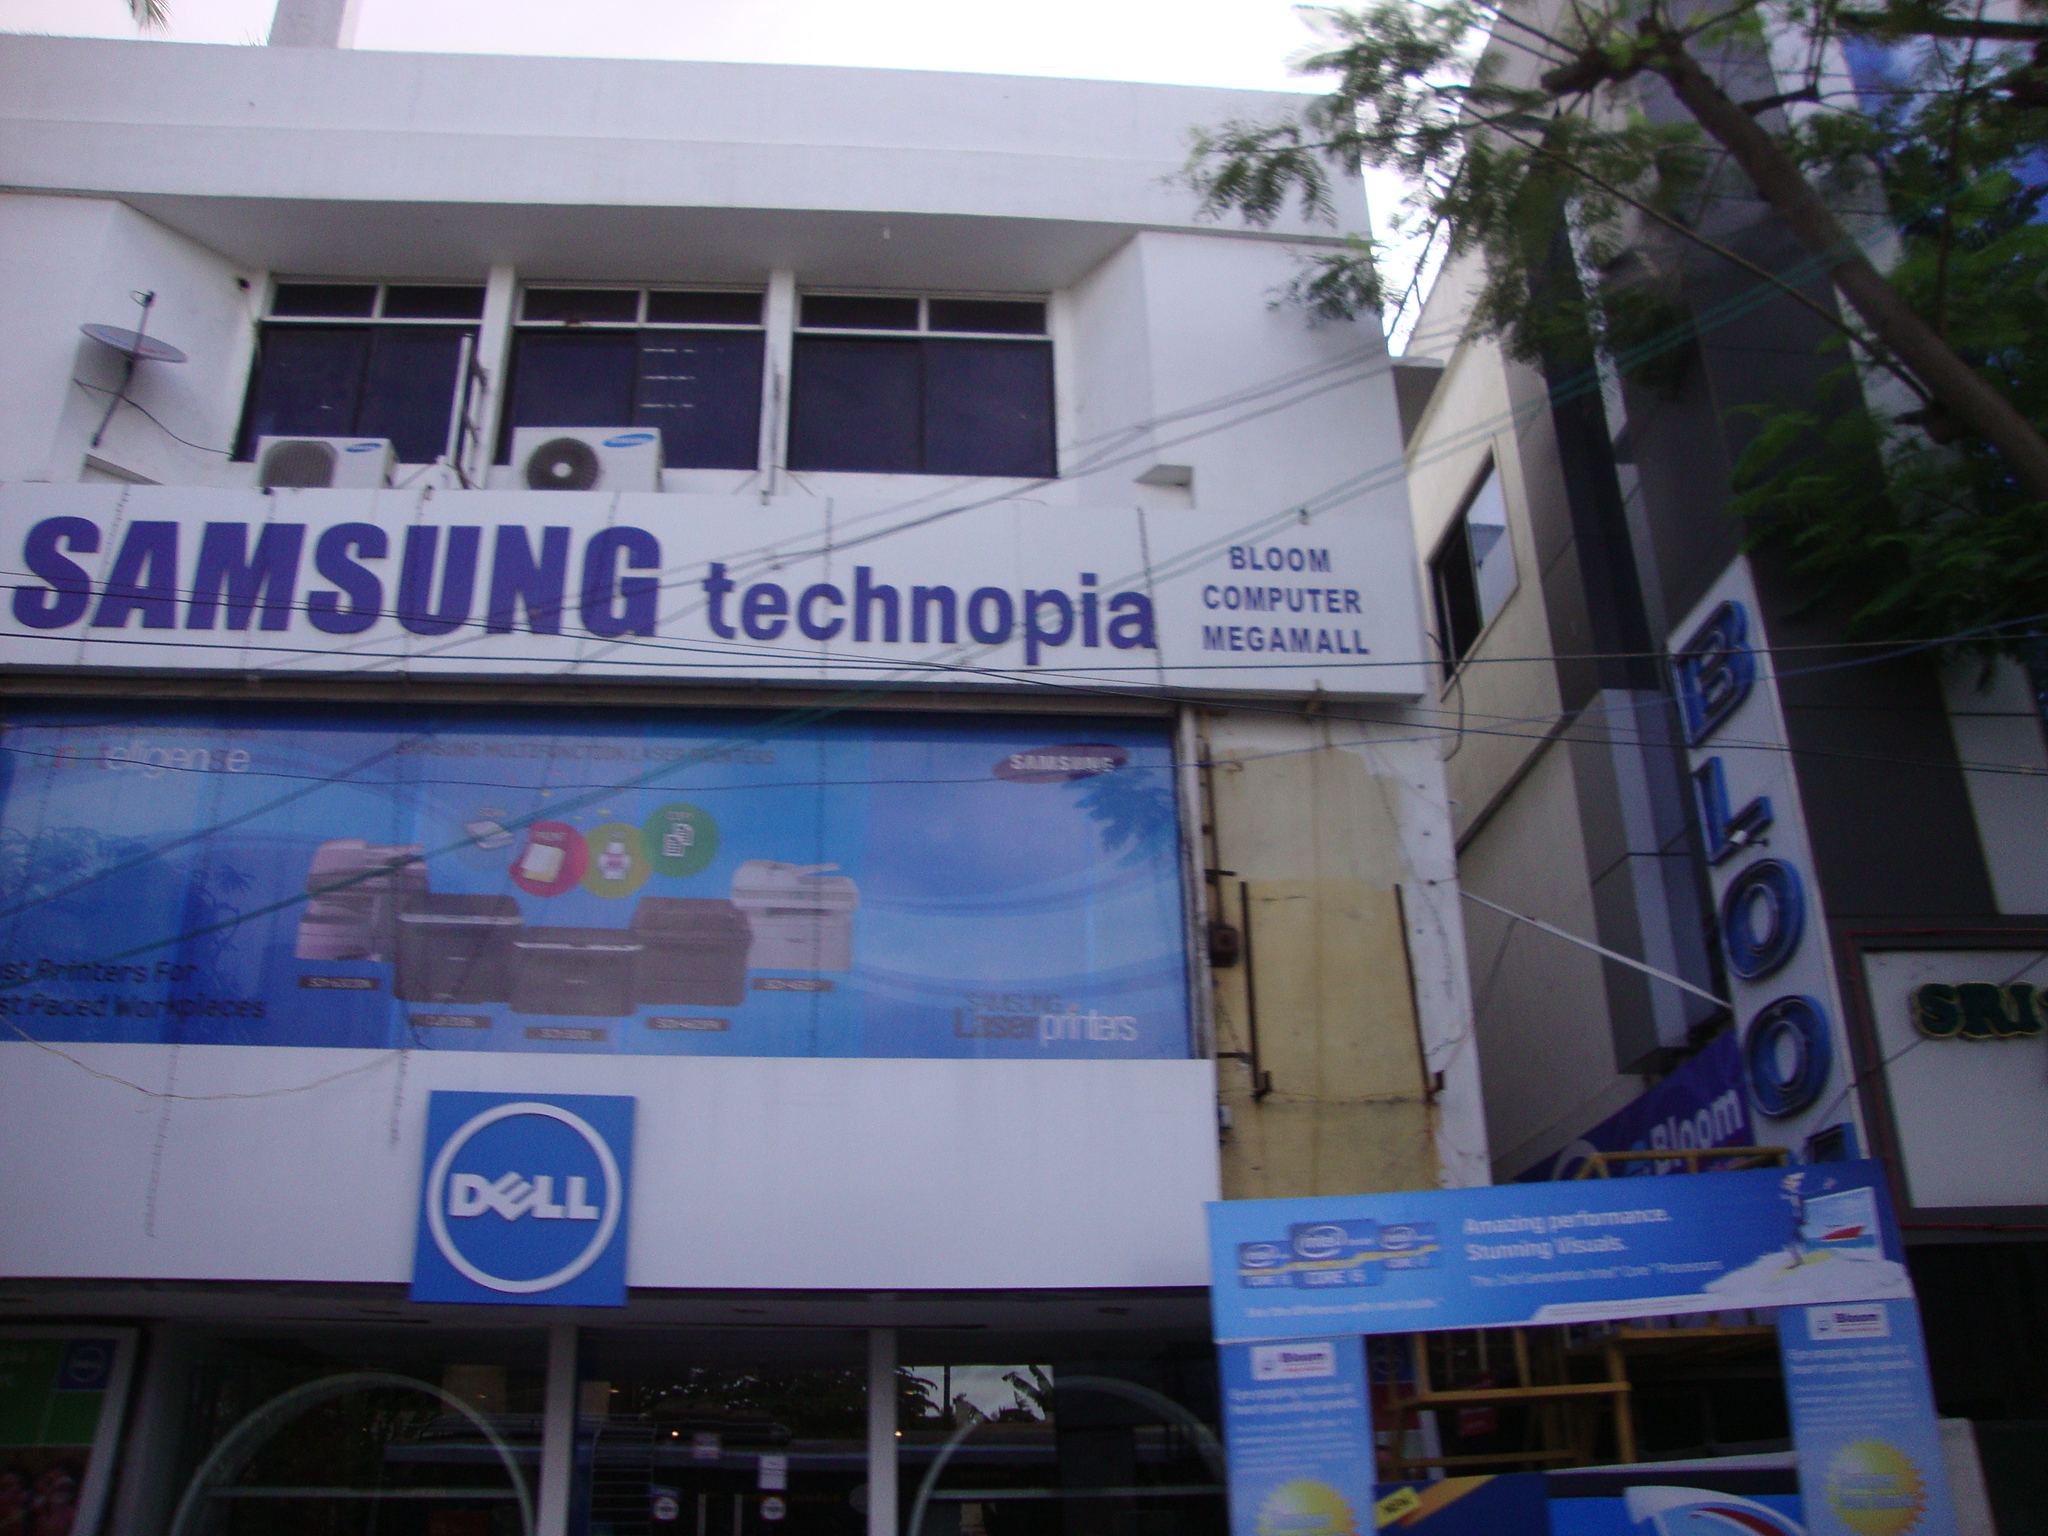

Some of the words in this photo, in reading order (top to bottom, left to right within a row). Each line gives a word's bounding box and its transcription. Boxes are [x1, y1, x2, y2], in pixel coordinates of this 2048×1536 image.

[1229, 546, 1332, 573] BLOOM
[12, 515, 662, 638] SAMSUNG
[703, 562, 1157, 664] technopia
[1203, 585, 1362, 614] COMPUTER
[1203, 625, 1370, 654] MEGAMALL
[1009, 753, 1115, 772] SAMSUNG
[1649, 1089, 1745, 1175] Bloom
[448, 1171, 599, 1221] DELL
[1464, 1214, 1547, 1235] Amazing
[1465, 1240, 1553, 1261] Stunning
